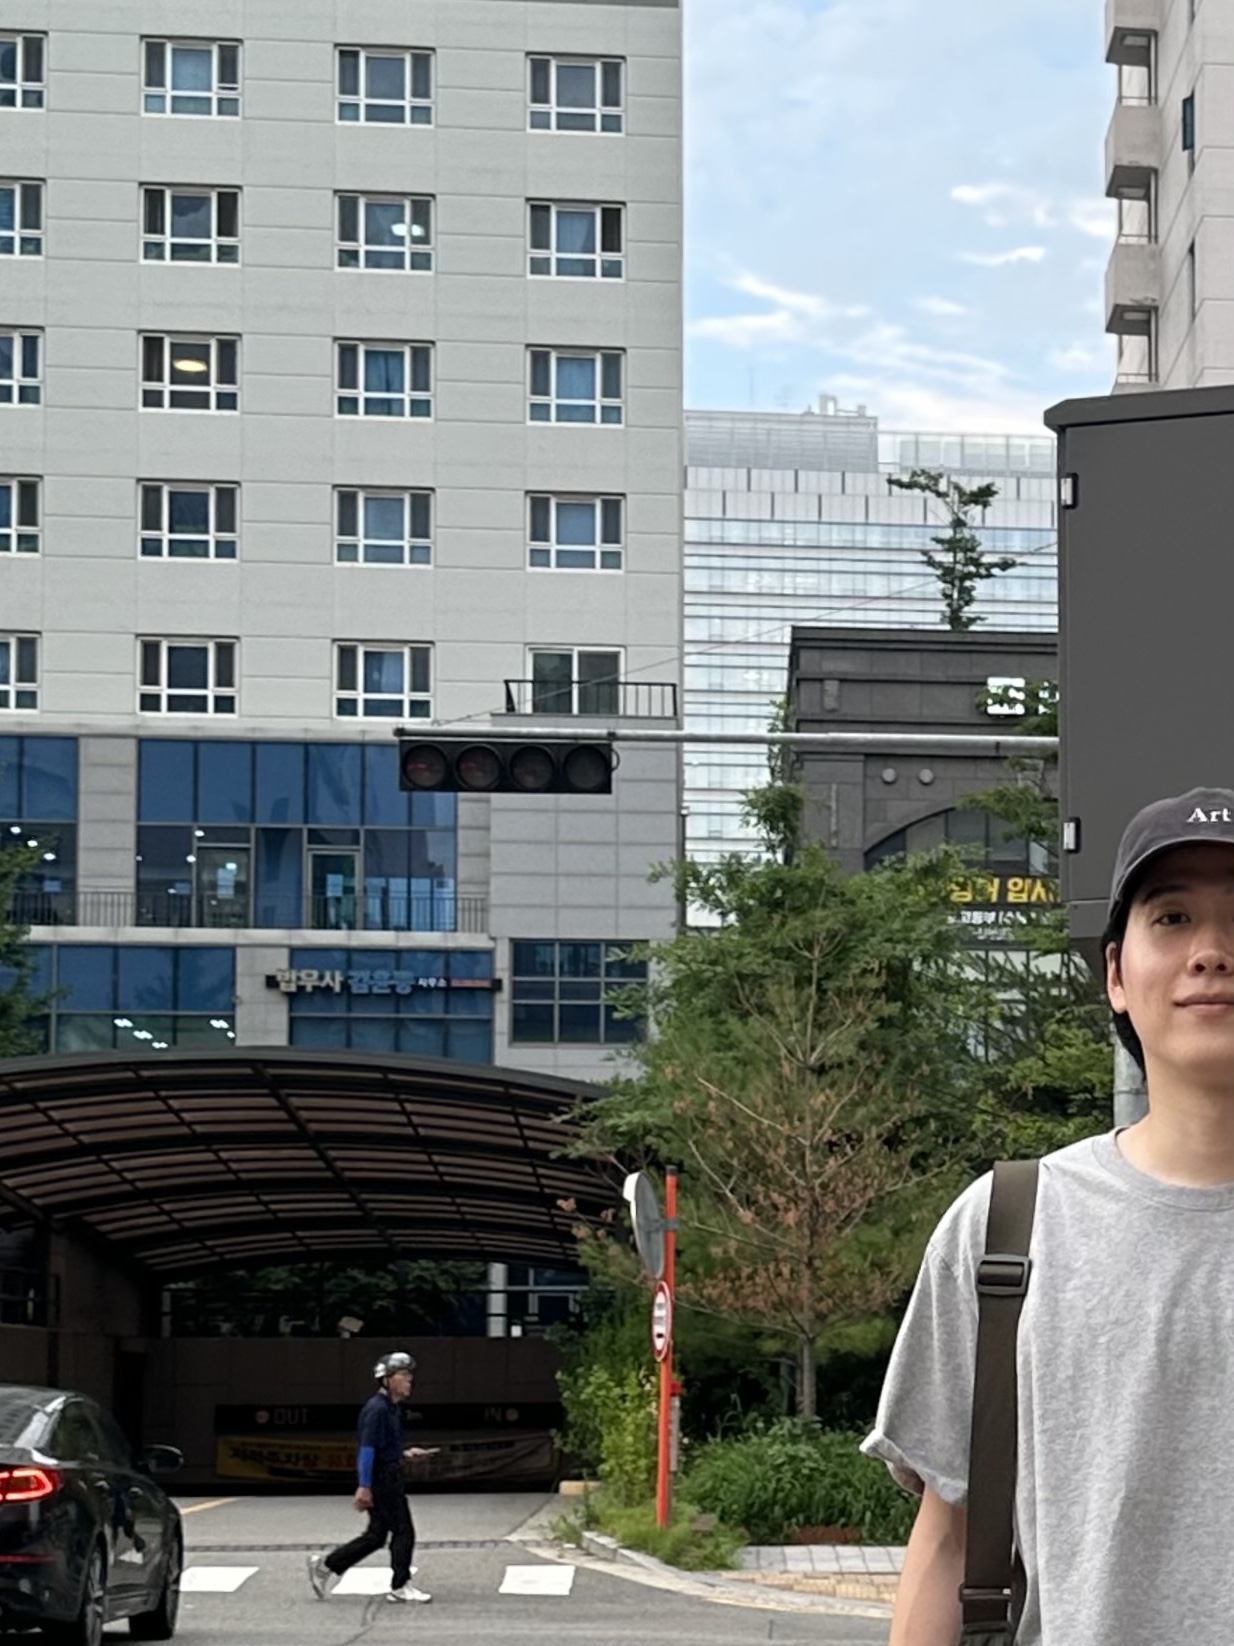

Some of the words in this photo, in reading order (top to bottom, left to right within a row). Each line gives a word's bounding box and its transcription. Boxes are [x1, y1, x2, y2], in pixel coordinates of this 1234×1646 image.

[1186, 808, 1231, 822] Art
[276, 968, 344, 993] 법무사
[273, 1407, 311, 1425] OUT
[484, 1406, 503, 1423] IN
